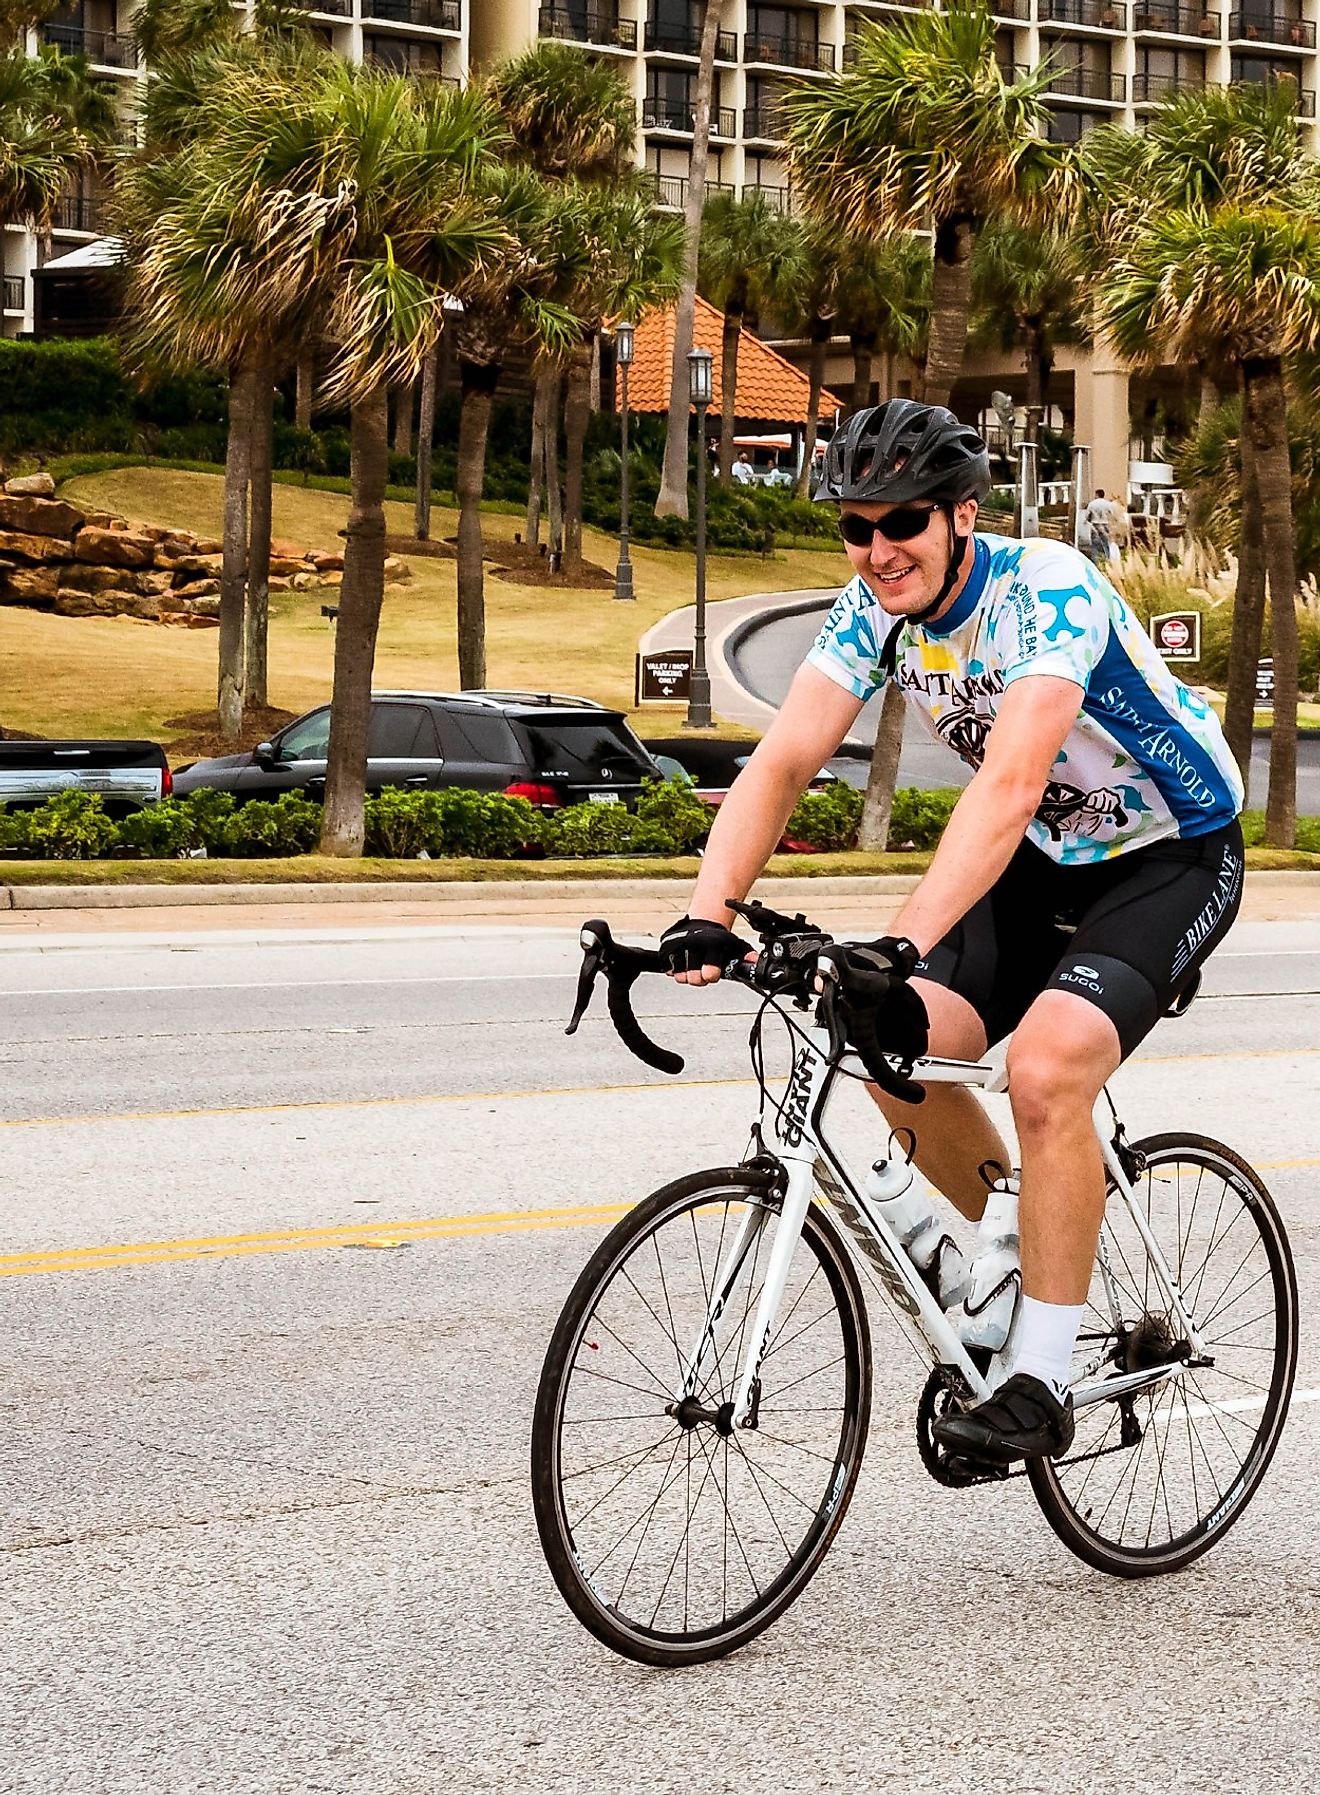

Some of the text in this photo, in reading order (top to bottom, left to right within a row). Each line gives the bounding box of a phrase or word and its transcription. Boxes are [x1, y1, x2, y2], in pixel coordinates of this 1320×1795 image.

[646, 662, 668, 670] VALET
[1138, 728, 1216, 808] ARNOLD
[1185, 902, 1217, 953] BIKE
